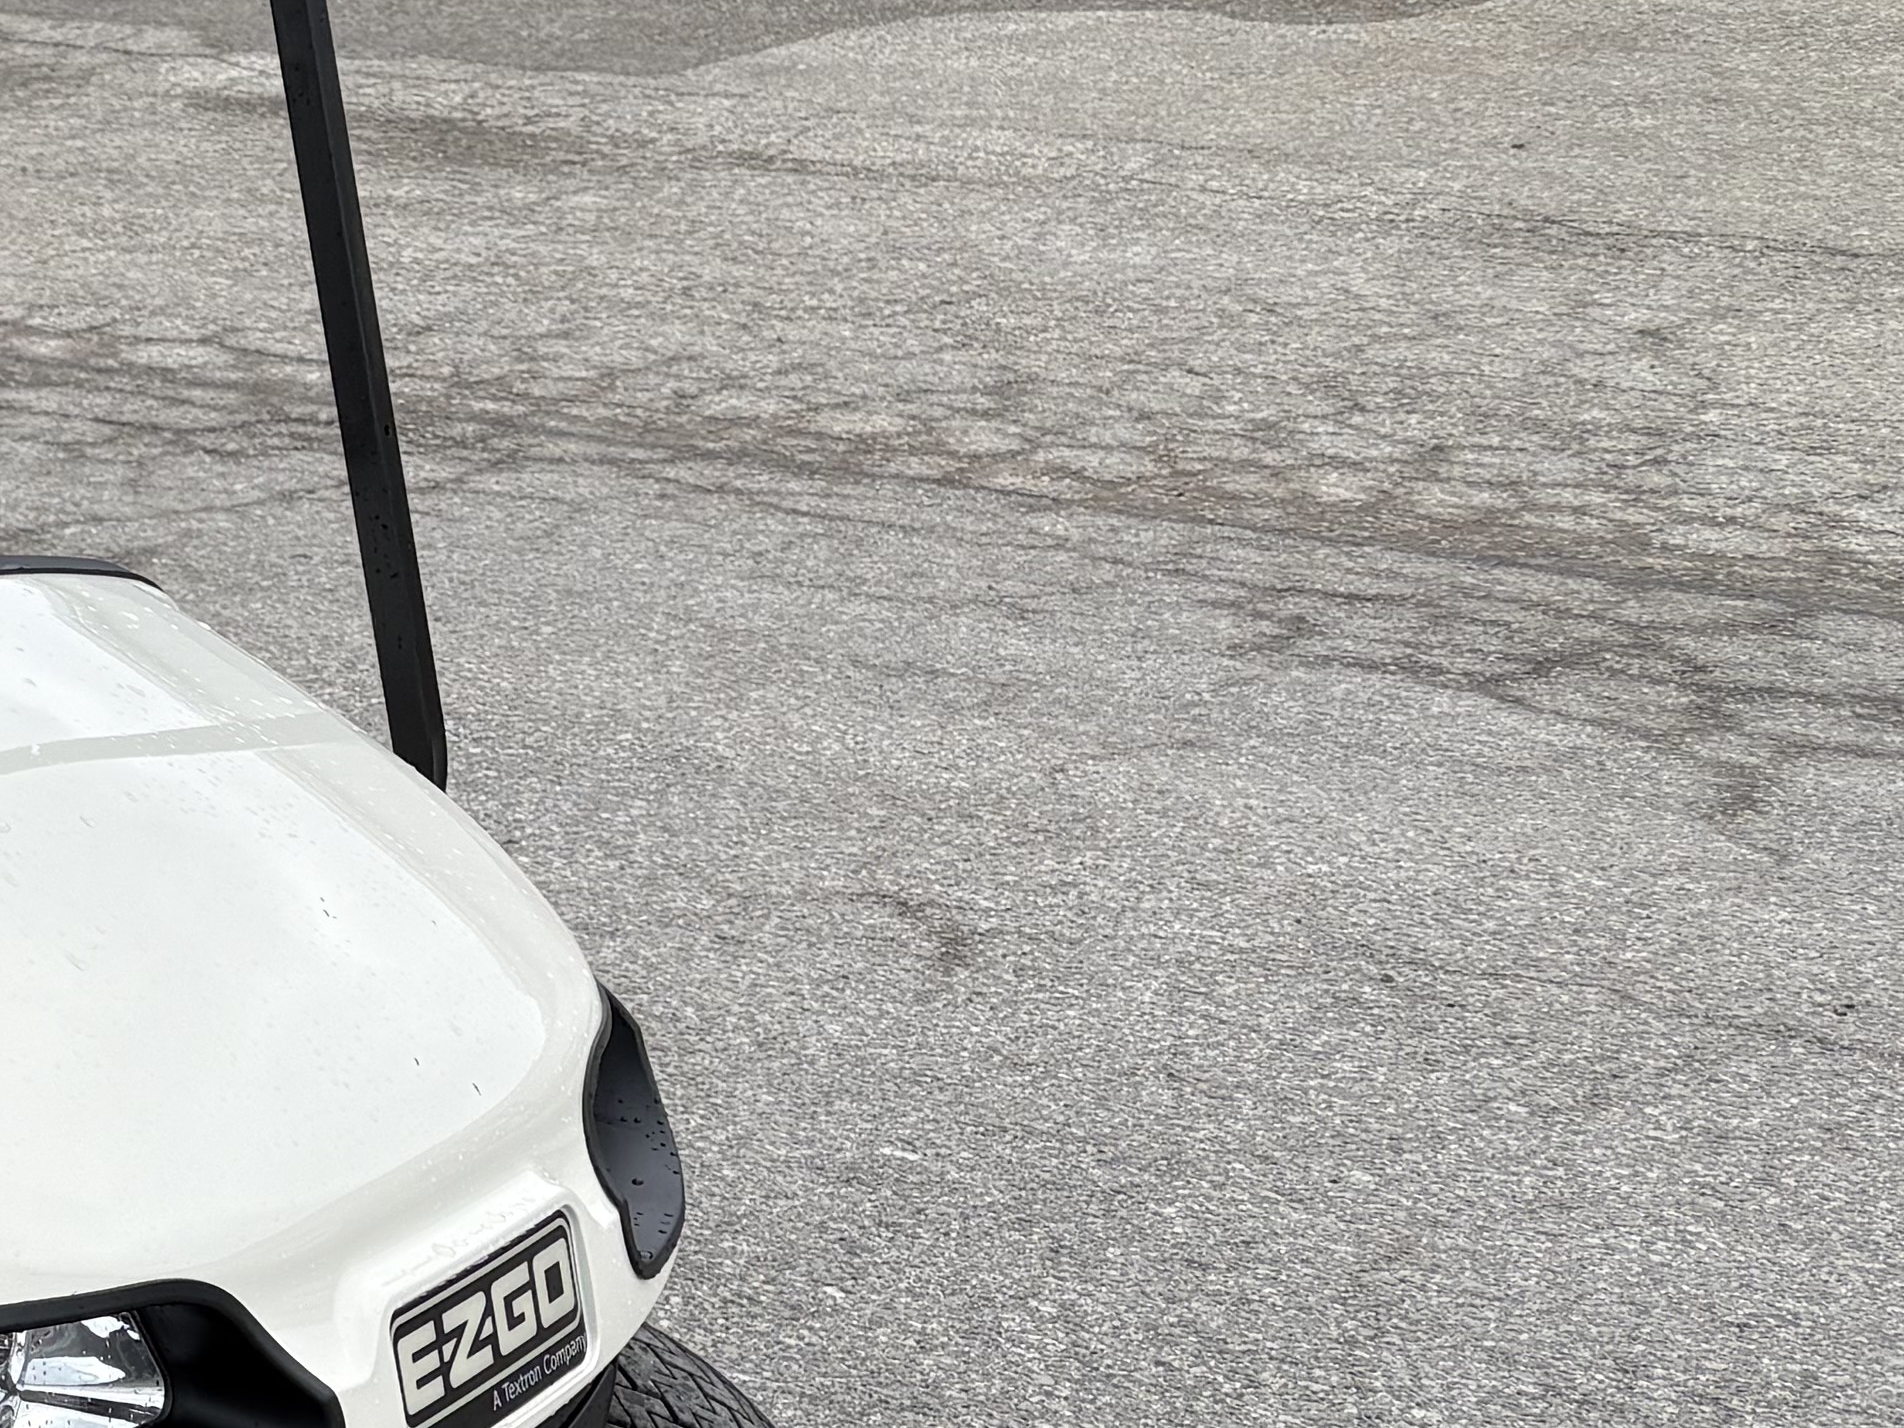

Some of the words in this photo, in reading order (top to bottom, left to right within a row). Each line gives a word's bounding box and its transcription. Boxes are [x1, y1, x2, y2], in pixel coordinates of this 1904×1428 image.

[492, 1389, 503, 1412] A
[504, 1366, 542, 1403] Textron
[543, 1333, 589, 1376] Company
